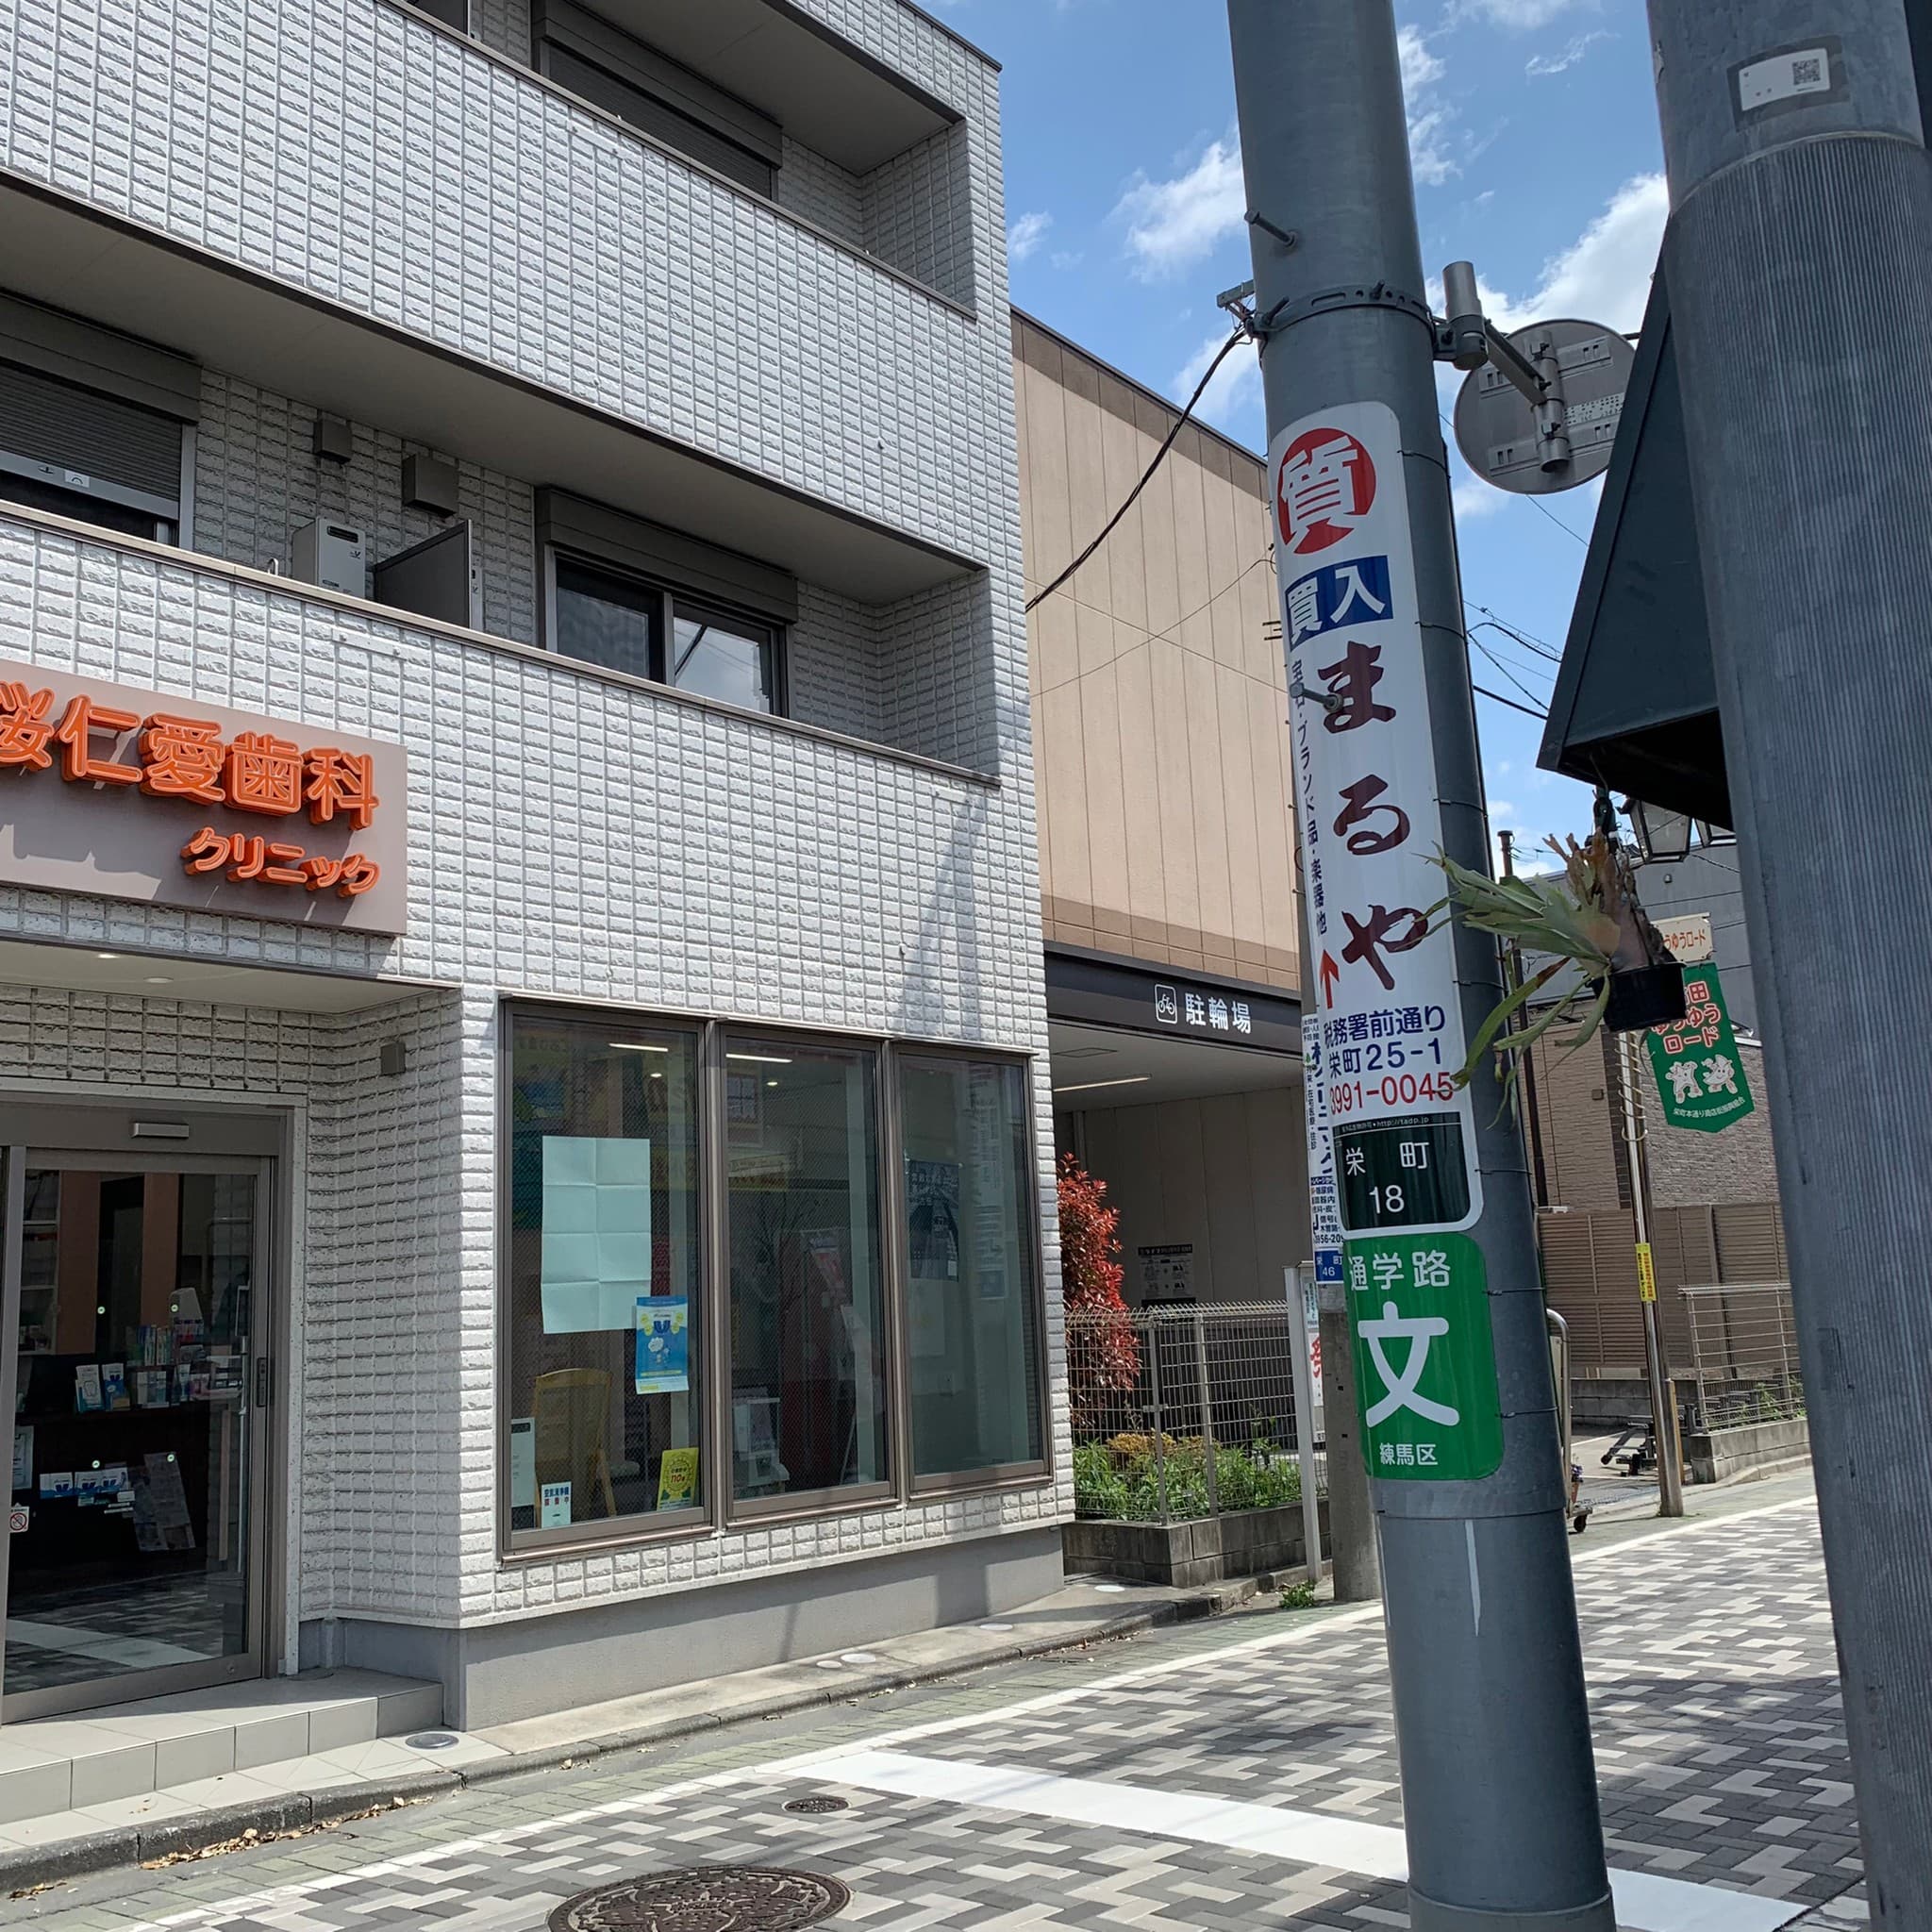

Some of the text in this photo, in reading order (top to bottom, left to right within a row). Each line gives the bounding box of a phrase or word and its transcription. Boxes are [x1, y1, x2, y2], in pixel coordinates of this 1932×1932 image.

[1289, 565, 1386, 643] 買入
[1317, 641, 1429, 991] まるや
[181, 825, 379, 898] クリニック
[1184, 992, 1252, 1034] 駐輪場
[1324, 1005, 1446, 1050] 税務署前通り
[1329, 1038, 1442, 1079] 栄町25-1
[1662, 1025, 1721, 1056] ロード
[1330, 1072, 1454, 1116] 3991-0045
[1345, 1141, 1430, 1177] 栄町
[1369, 1184, 1406, 1215] 18
[1322, 1266, 1336, 1276] 46
[1348, 1250, 1452, 1291] 通学路
[1357, 1301, 1461, 1428] 文
[1379, 1441, 1439, 1467] 練馬区
